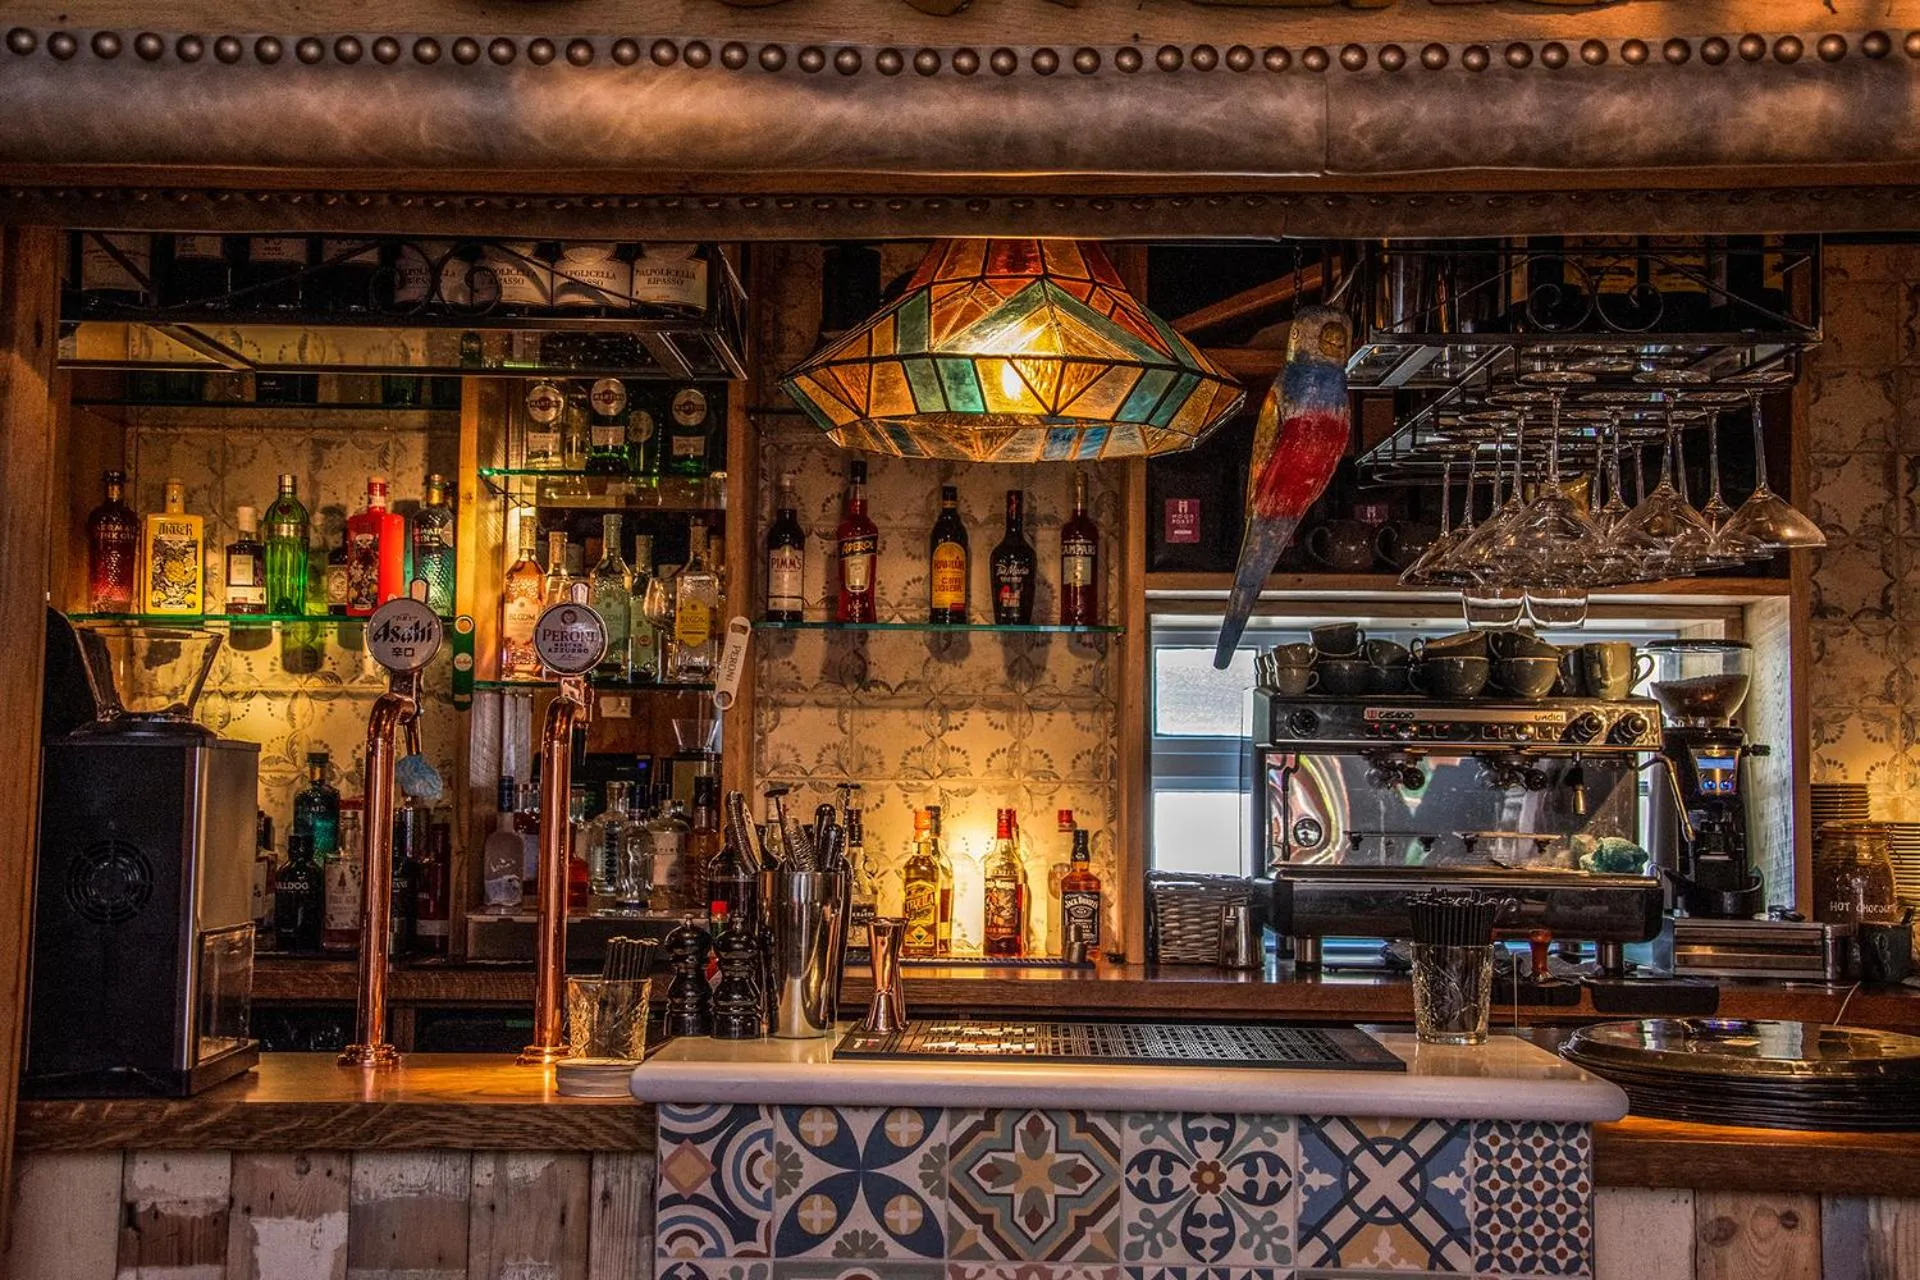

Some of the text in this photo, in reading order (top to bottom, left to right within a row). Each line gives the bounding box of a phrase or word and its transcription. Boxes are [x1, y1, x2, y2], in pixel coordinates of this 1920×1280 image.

[771, 556, 802, 569] PIMM'S
[373, 620, 432, 643] Asahi
[543, 630, 596, 642] PERONI
[726, 644, 742, 682] PERONI
[1830, 901, 1851, 912] HOT
